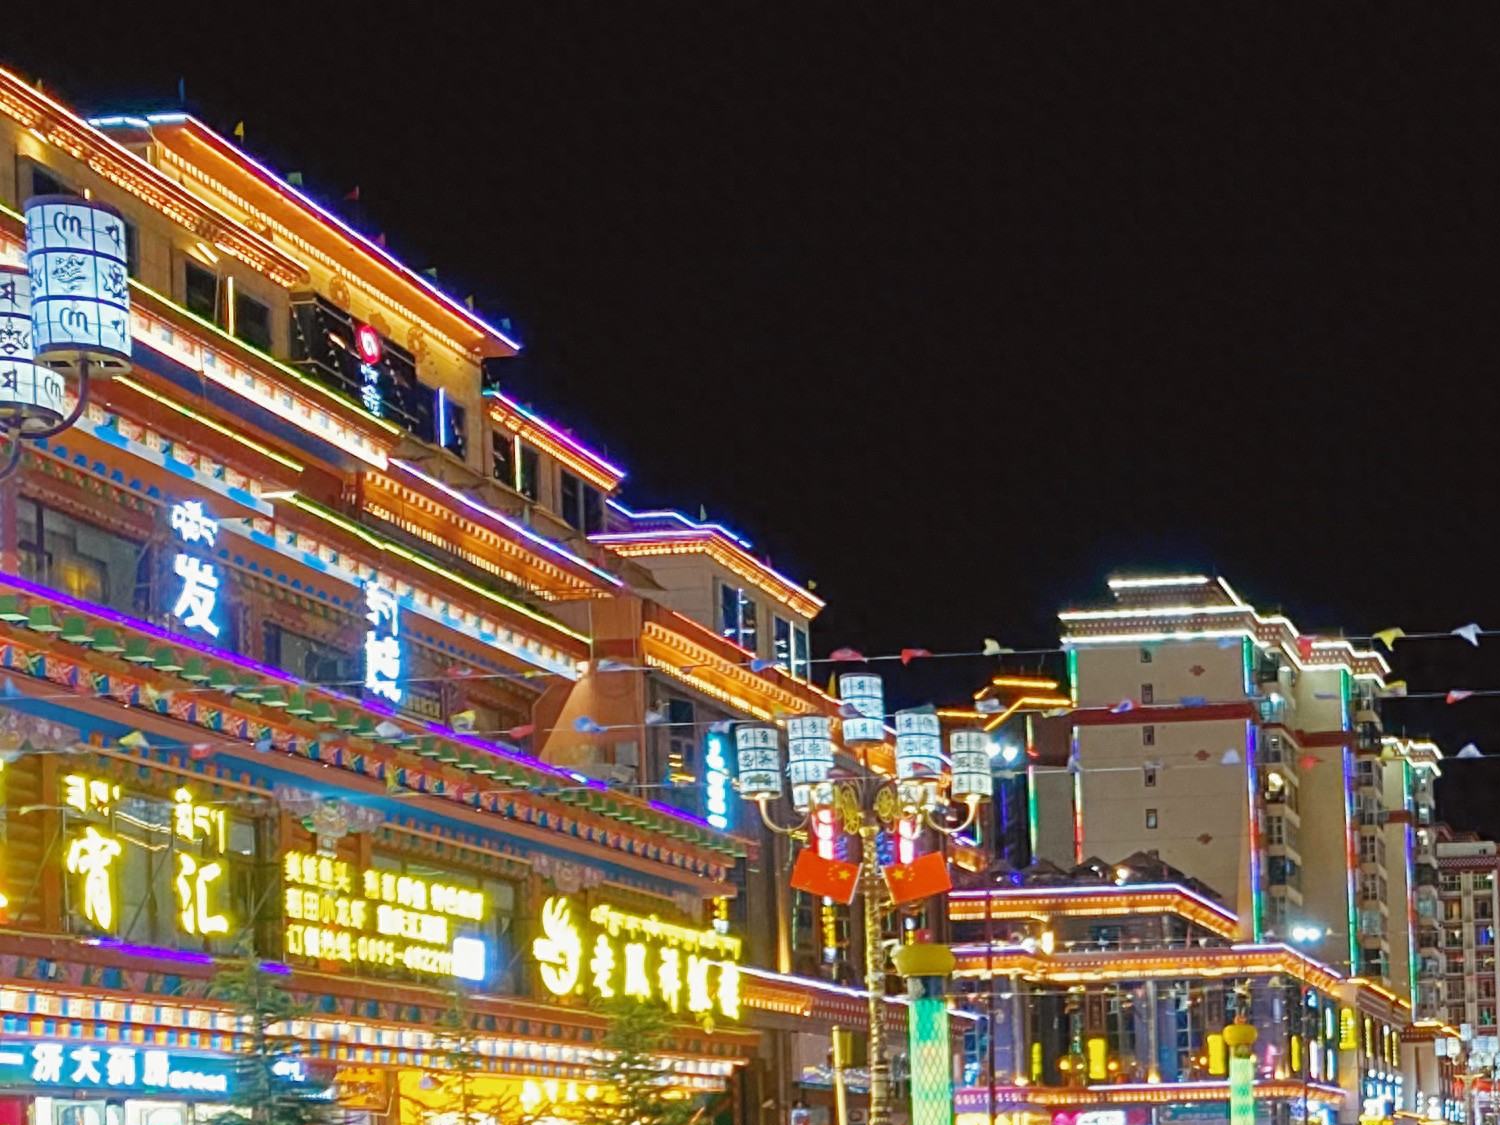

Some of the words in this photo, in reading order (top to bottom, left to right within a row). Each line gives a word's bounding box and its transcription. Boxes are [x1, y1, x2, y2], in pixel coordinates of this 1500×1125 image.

[591, 934, 741, 1021] 老凤祥银楼
